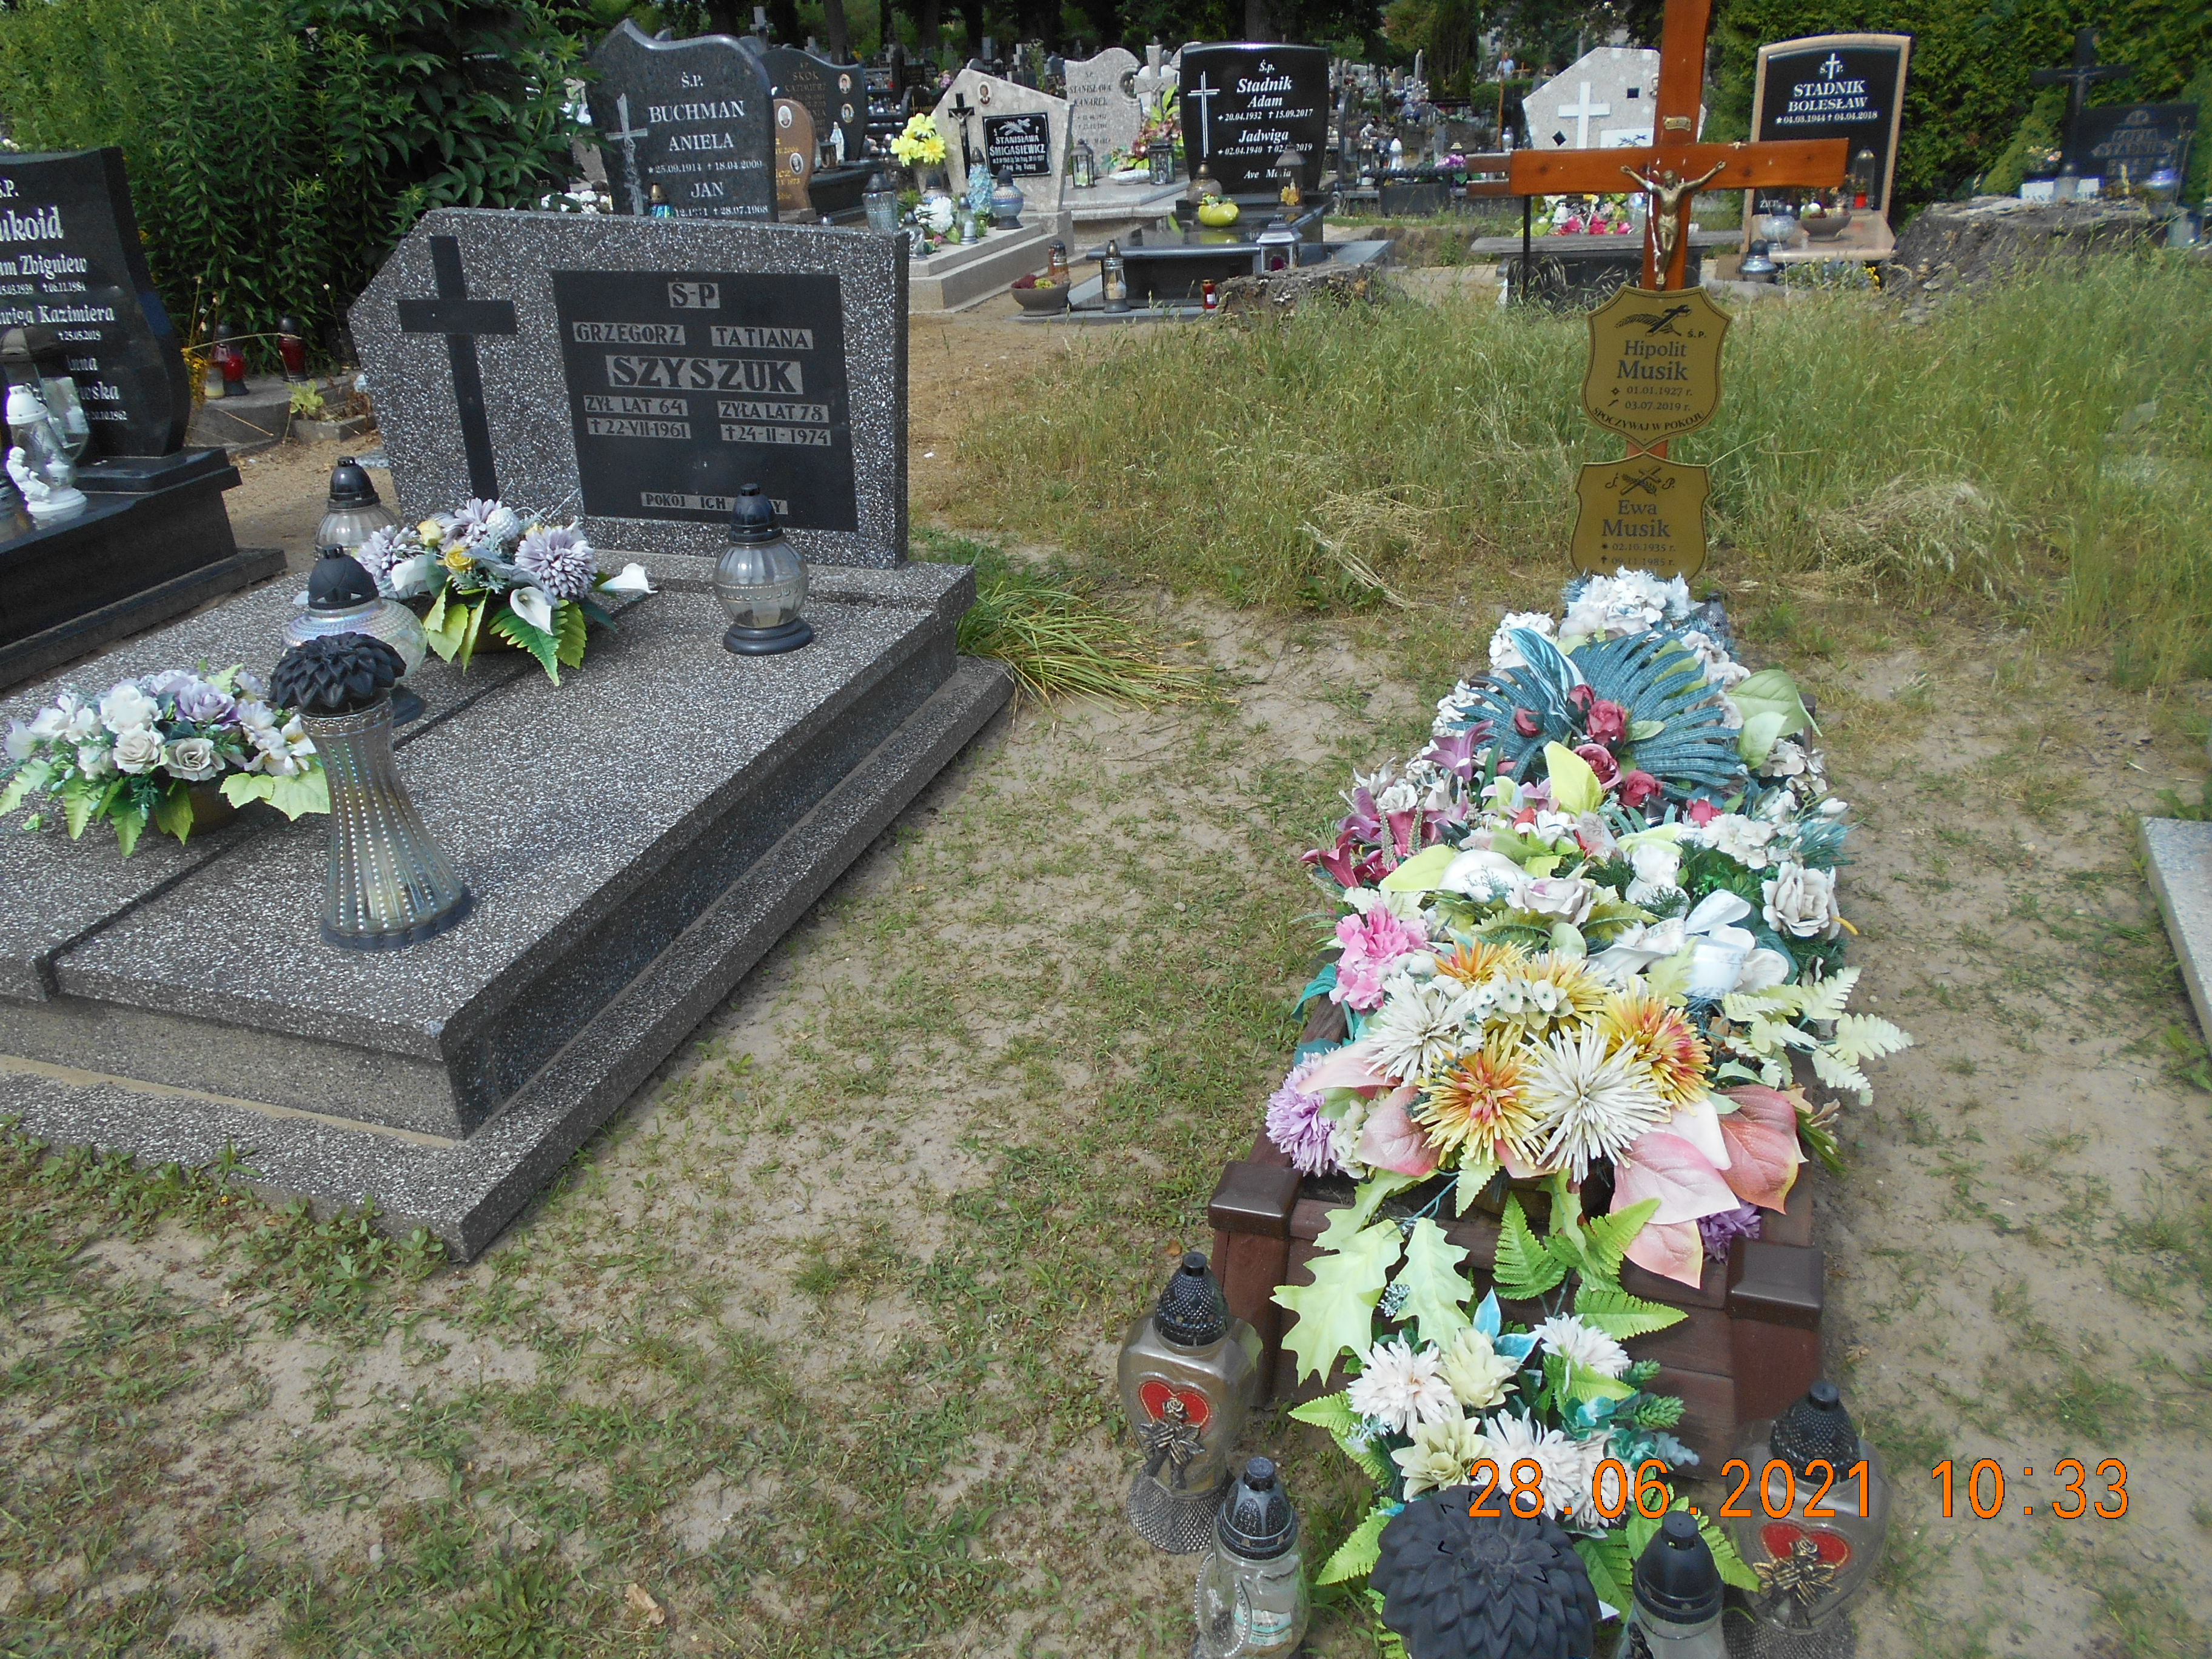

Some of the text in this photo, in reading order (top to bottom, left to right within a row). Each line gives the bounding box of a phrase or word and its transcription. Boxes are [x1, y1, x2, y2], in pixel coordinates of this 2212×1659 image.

[1236, 75, 1293, 92] Stadnik
[1794, 80, 1866, 97] STADNIK
[1247, 94, 1283, 108] Adam
[1788, 97, 1869, 112] BOLESŁAW
[649, 101, 745, 123] BUCHMAN
[1225, 109, 1313, 121] 20.04.1932 15.09.2017
[669, 132, 734, 151] ANIELA
[1238, 129, 1289, 144] Jadwiga
[1225, 146, 1262, 155] 02.04.1940
[1244, 170, 1259, 179] Ave
[691, 182, 724, 198] JAN
[20, 253, 87, 280] Zbigniew
[38, 304, 115, 323] Kazimiera
[577, 324, 809, 347] GRZEGORZ TATIANA
[1624, 340, 1687, 359] Hipolit
[613, 357, 797, 392] SZYSZUK
[1617, 360, 1688, 380] Musik
[1627, 386, 1683, 397] 01.01.1927
[622, 398, 651, 413] LAT
[660, 400, 683, 415] 64
[765, 404, 795, 420] LAT
[801, 406, 823, 421] 78
[1625, 401, 1681, 411] 03.07.2019
[1593, 407, 1649, 431] SPOCZYWAJ
[1664, 412, 1704, 430] POKOJU
[700, 497, 726, 509] ICH
[1618, 500, 1657, 515] Ewa
[1601, 519, 1672, 537] Musik
